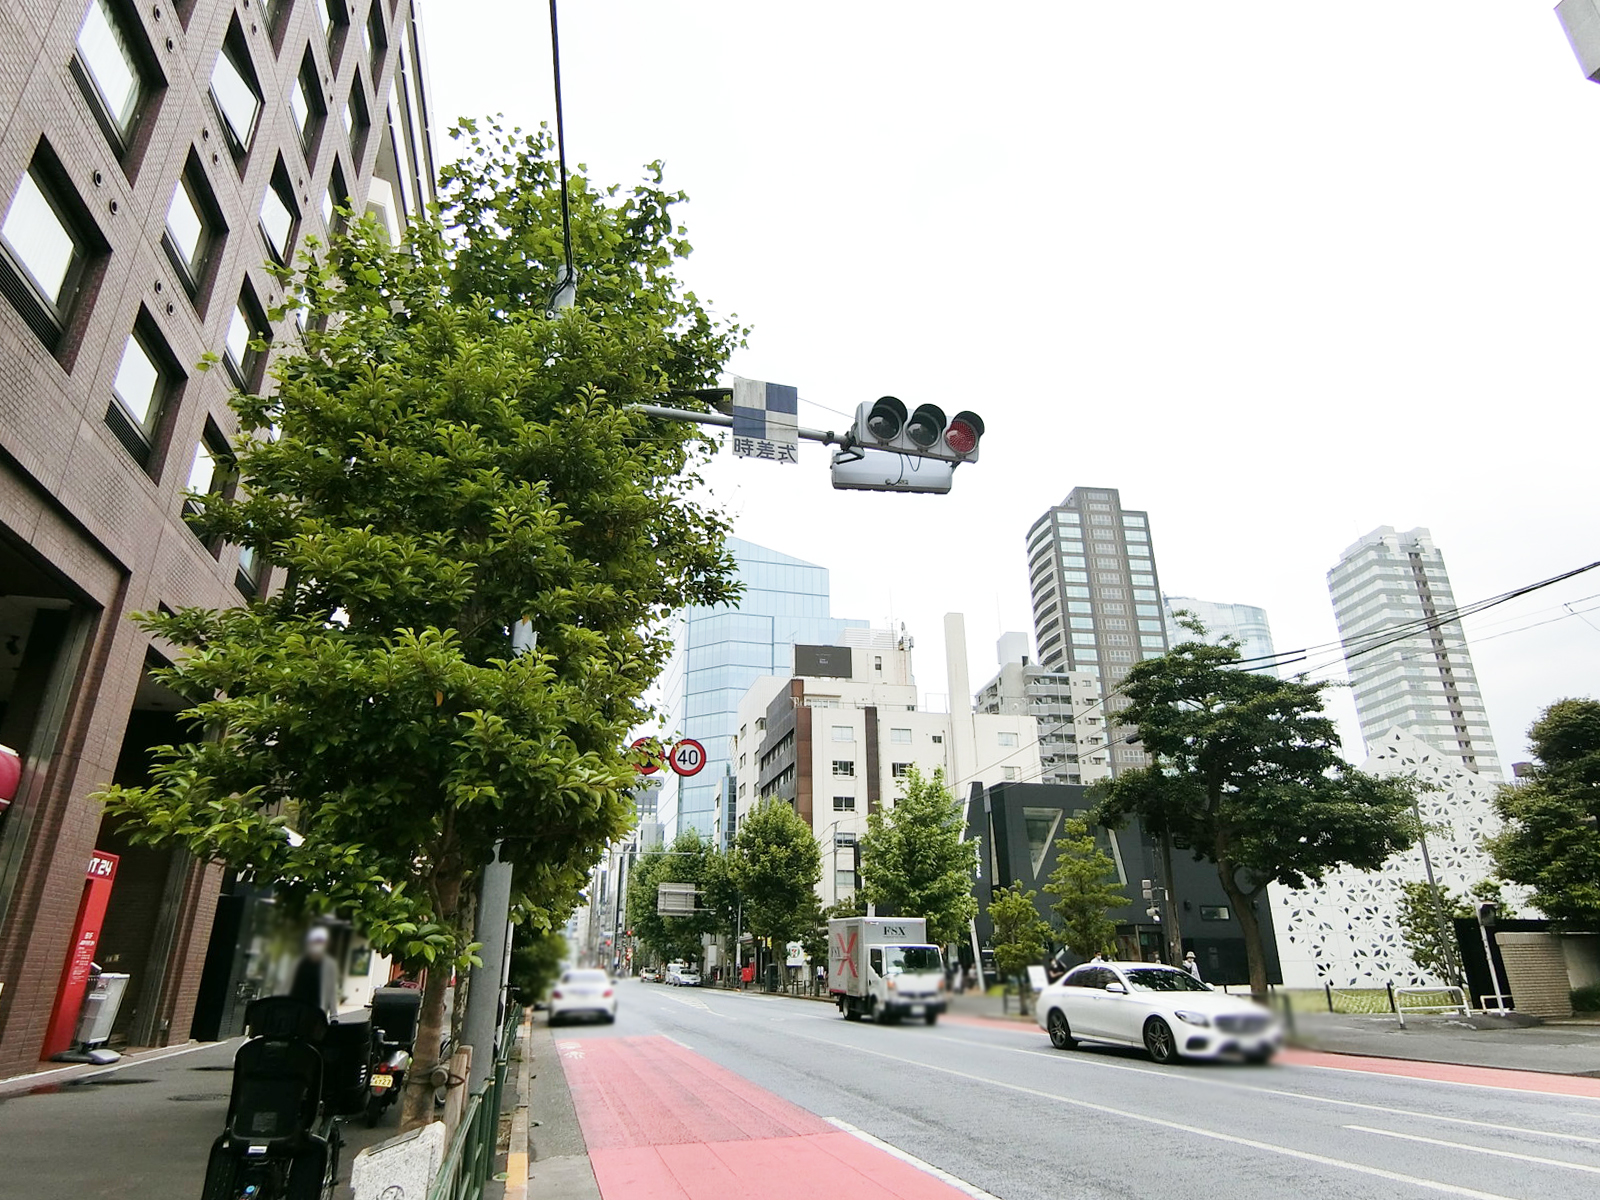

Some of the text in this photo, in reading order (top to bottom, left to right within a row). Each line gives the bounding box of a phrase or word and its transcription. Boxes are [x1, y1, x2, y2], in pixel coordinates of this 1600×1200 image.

[734, 438, 797, 463] 時差式
[677, 749, 699, 766] 40
[883, 926, 906, 936] FSX
